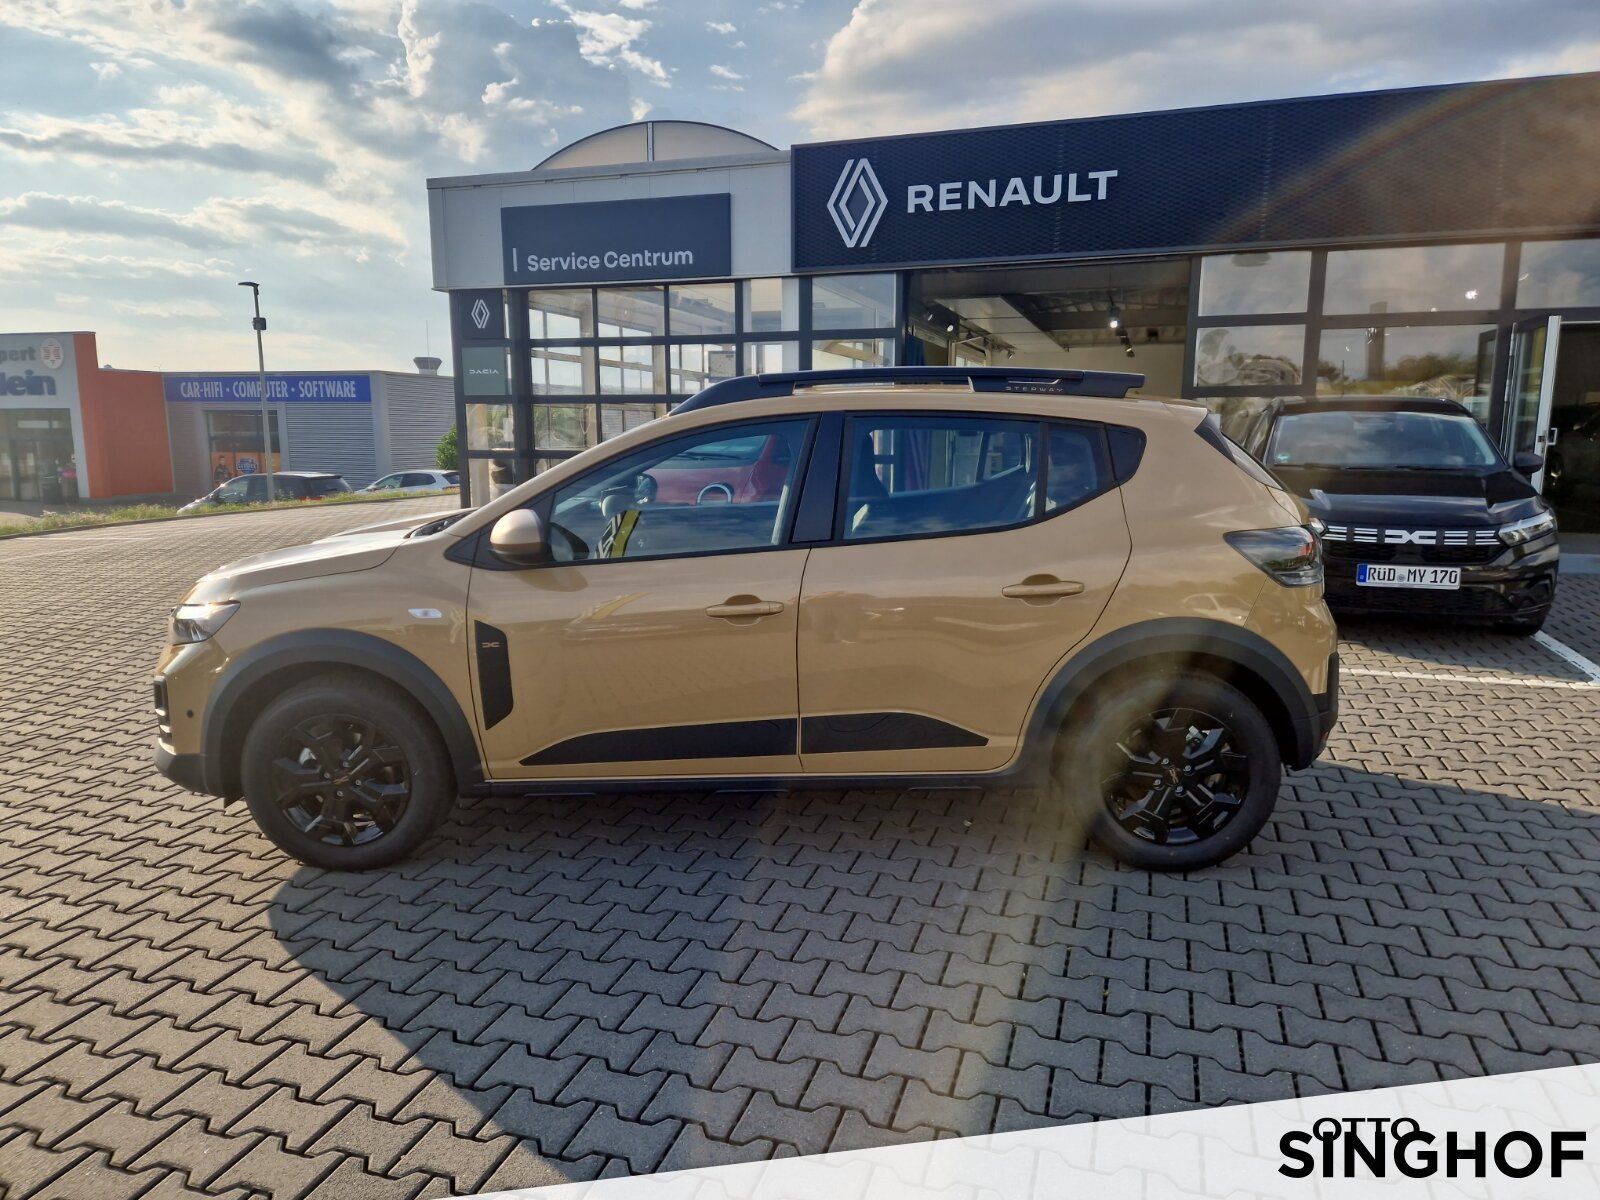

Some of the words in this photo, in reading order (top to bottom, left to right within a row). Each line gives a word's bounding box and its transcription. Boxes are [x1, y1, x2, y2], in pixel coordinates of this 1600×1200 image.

[907, 170, 1118, 213] RENAULT
[527, 252, 600, 272] Service
[603, 250, 693, 268] Centrum
[180, 382, 224, 398] CAR-HIFI
[298, 380, 356, 398] SOFTWARE
[1367, 567, 1396, 582] RÜD
[1407, 568, 1426, 583] MY
[1429, 569, 1458, 584] 170
